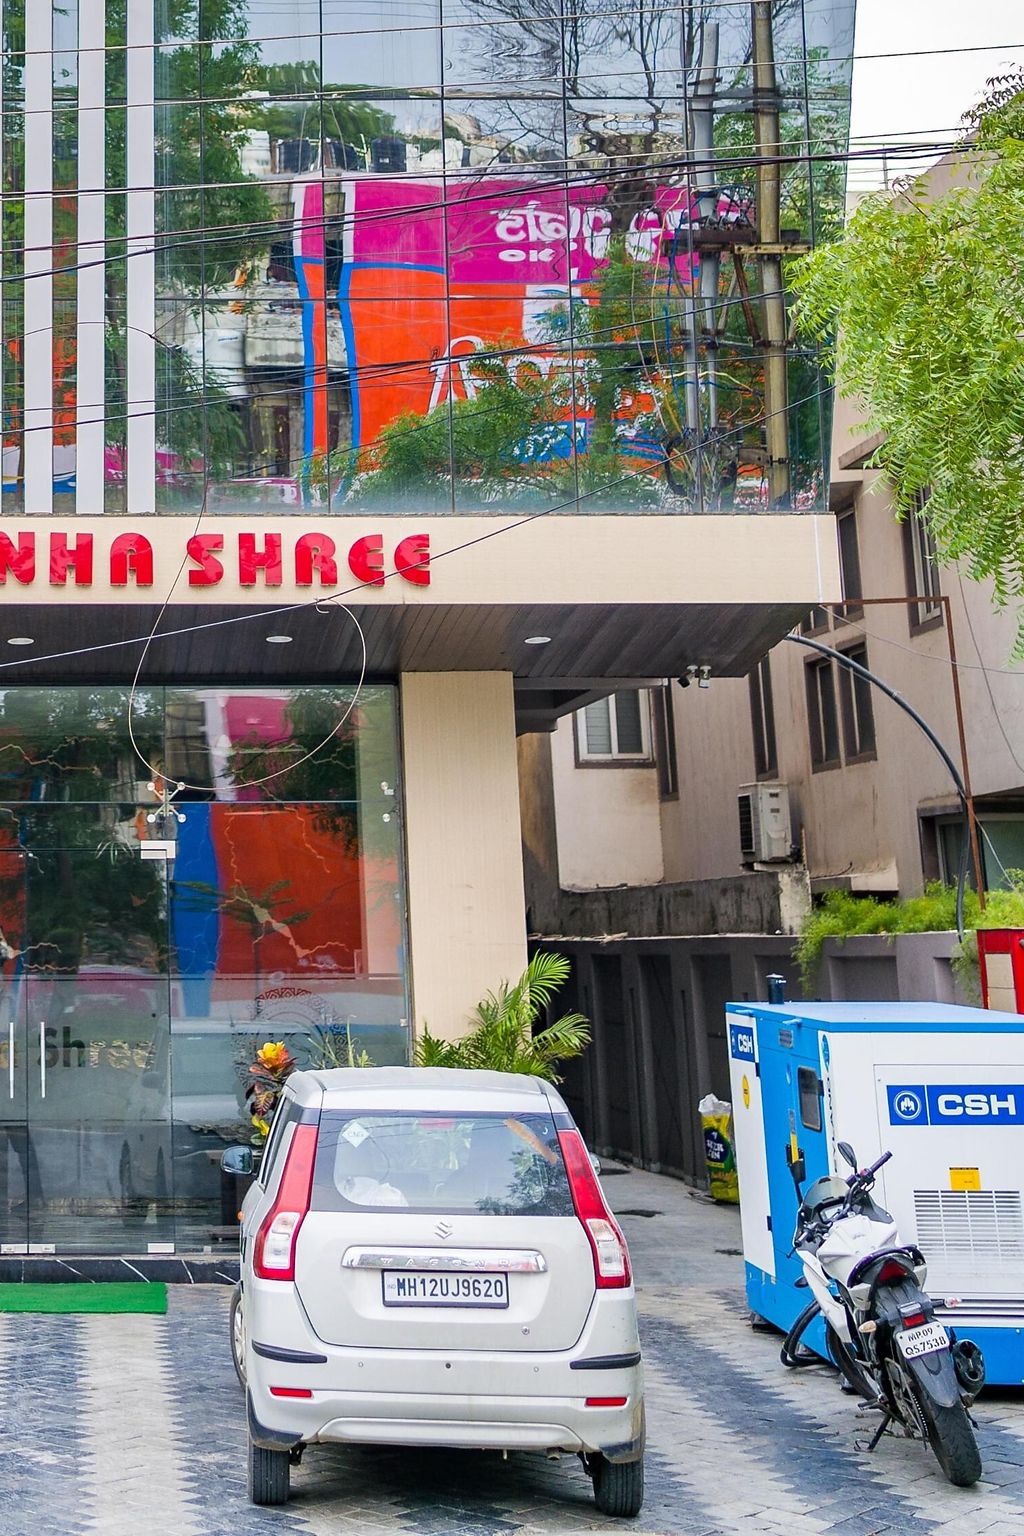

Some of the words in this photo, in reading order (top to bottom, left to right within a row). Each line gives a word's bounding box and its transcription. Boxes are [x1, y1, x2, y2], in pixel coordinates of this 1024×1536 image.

[187, 532, 431, 587] SHREE
[37, 1026, 155, 1069] Shree
[737, 1033, 753, 1054] CSH
[937, 1094, 1017, 1116] CSH
[396, 1277, 504, 1298] MH12UJ9620
